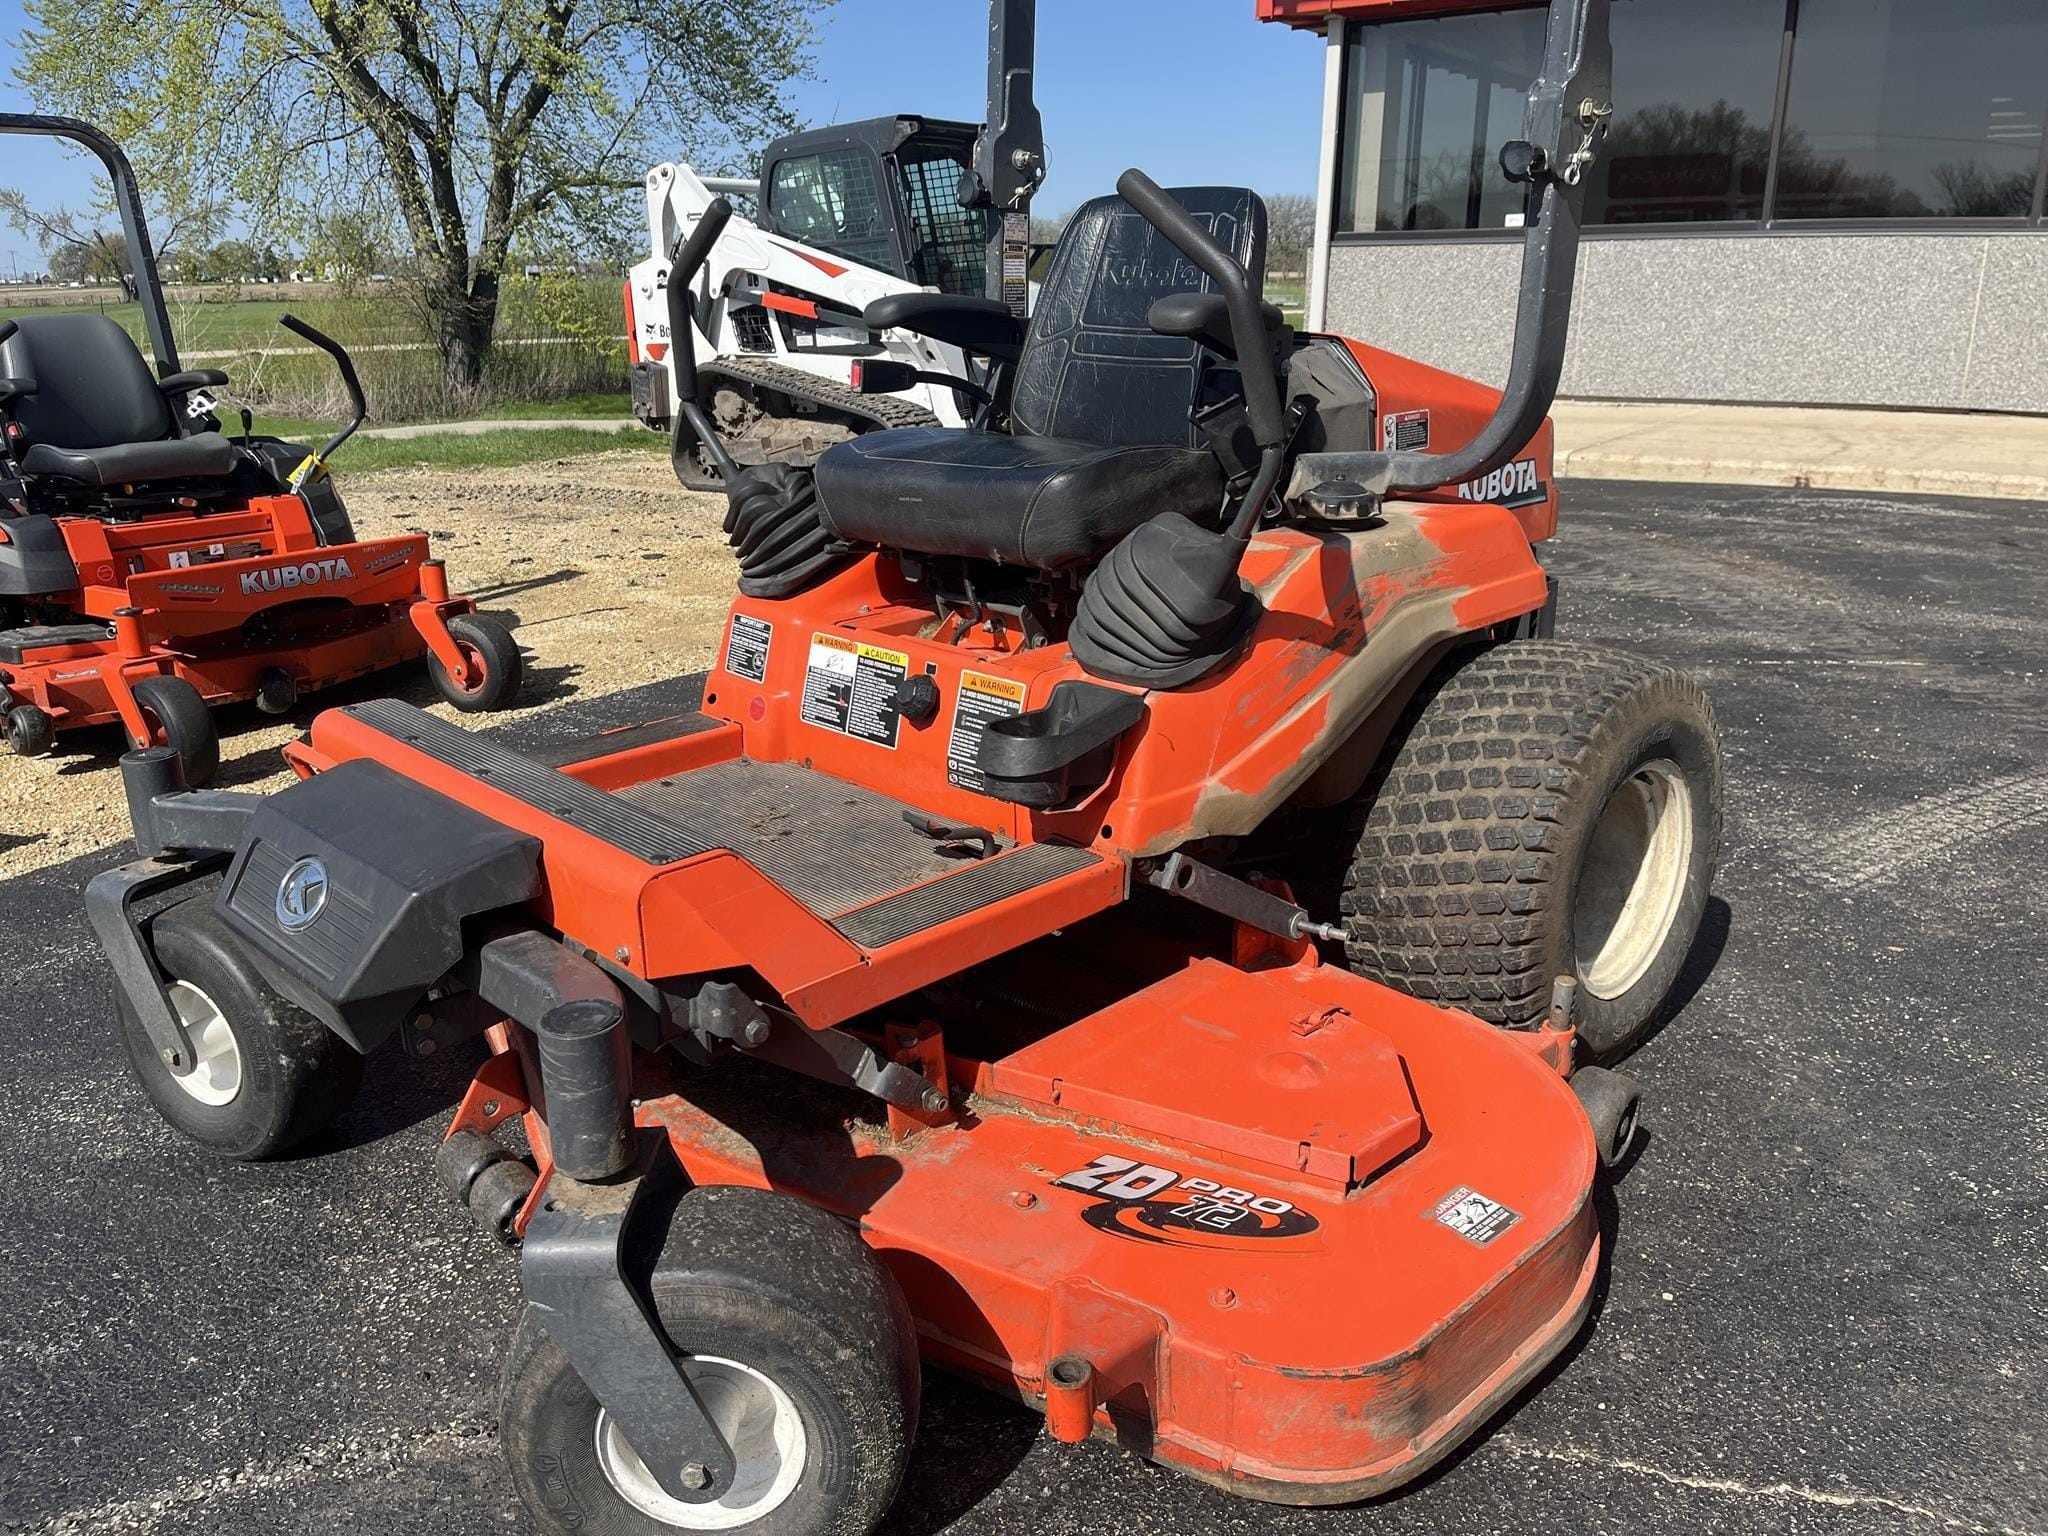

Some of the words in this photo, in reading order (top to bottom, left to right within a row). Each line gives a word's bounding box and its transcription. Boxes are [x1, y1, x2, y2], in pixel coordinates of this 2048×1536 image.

[240, 558, 353, 595] KUBOTA
[824, 637, 853, 652] WARNING
[870, 649, 900, 663] CAUTION
[980, 679, 1015, 696] WARNING
[1055, 1153, 1181, 1200] ZD
[1178, 1177, 1294, 1214] PRO
[1435, 1187, 1472, 1214] DANGER
[1170, 1194, 1249, 1229] 72
